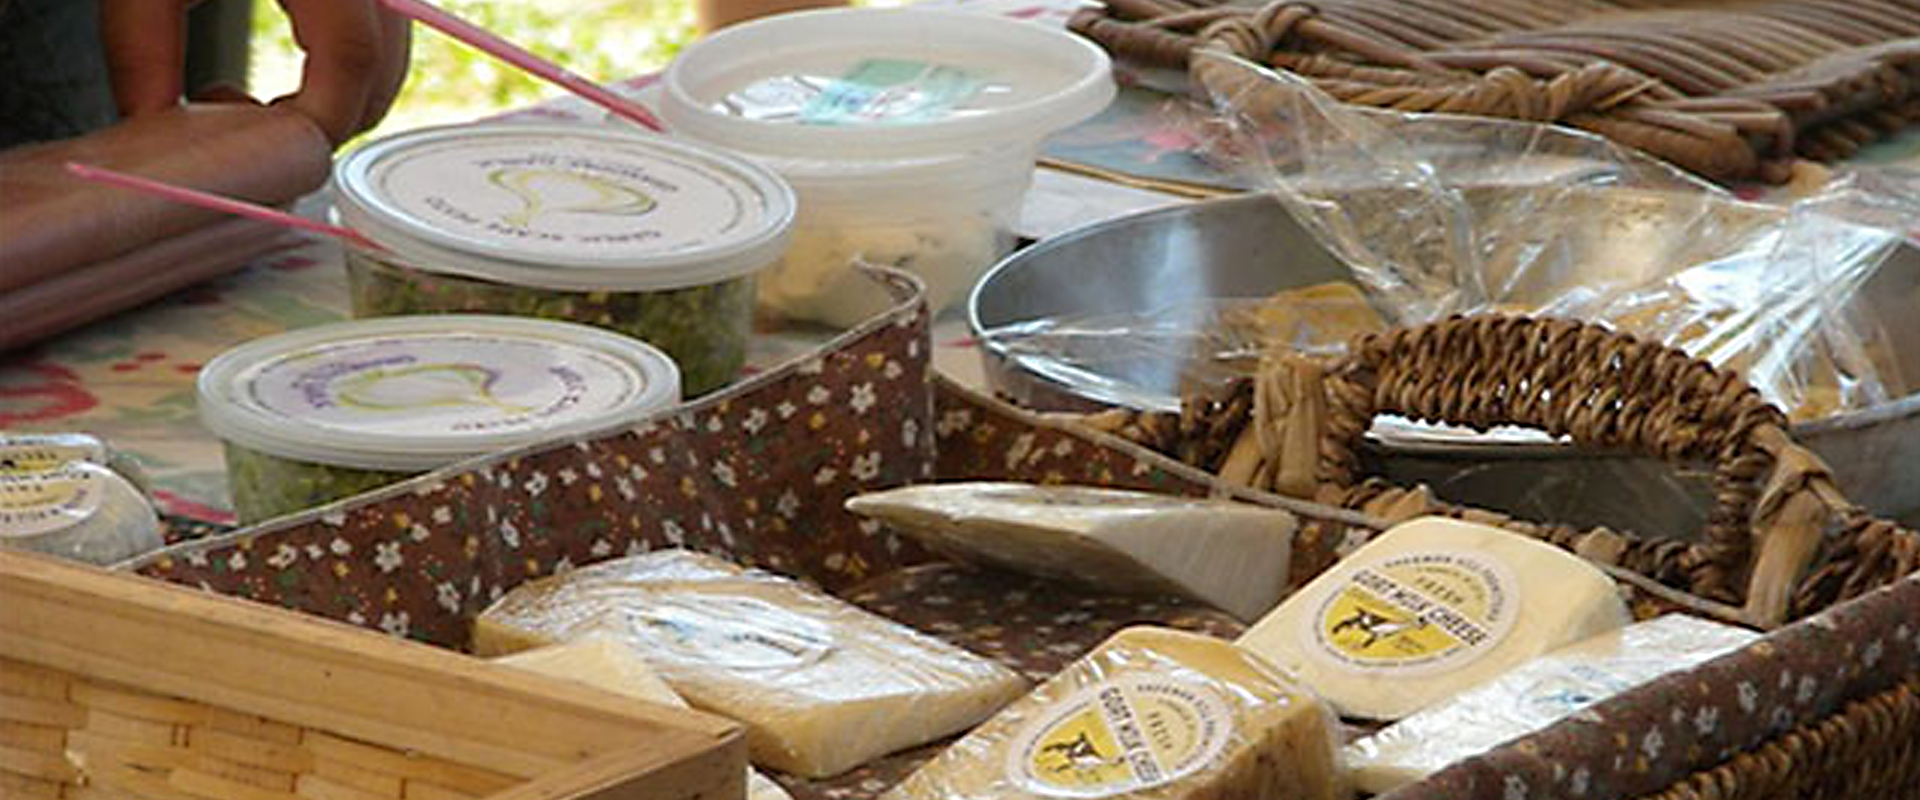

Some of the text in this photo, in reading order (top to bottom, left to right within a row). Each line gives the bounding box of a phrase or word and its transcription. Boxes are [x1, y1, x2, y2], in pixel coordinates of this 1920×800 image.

[1351, 568, 1397, 596] GOAT
[1388, 590, 1434, 614] MILK
[1427, 605, 1489, 646] CHEESE
[1099, 685, 1133, 722] GOAT
